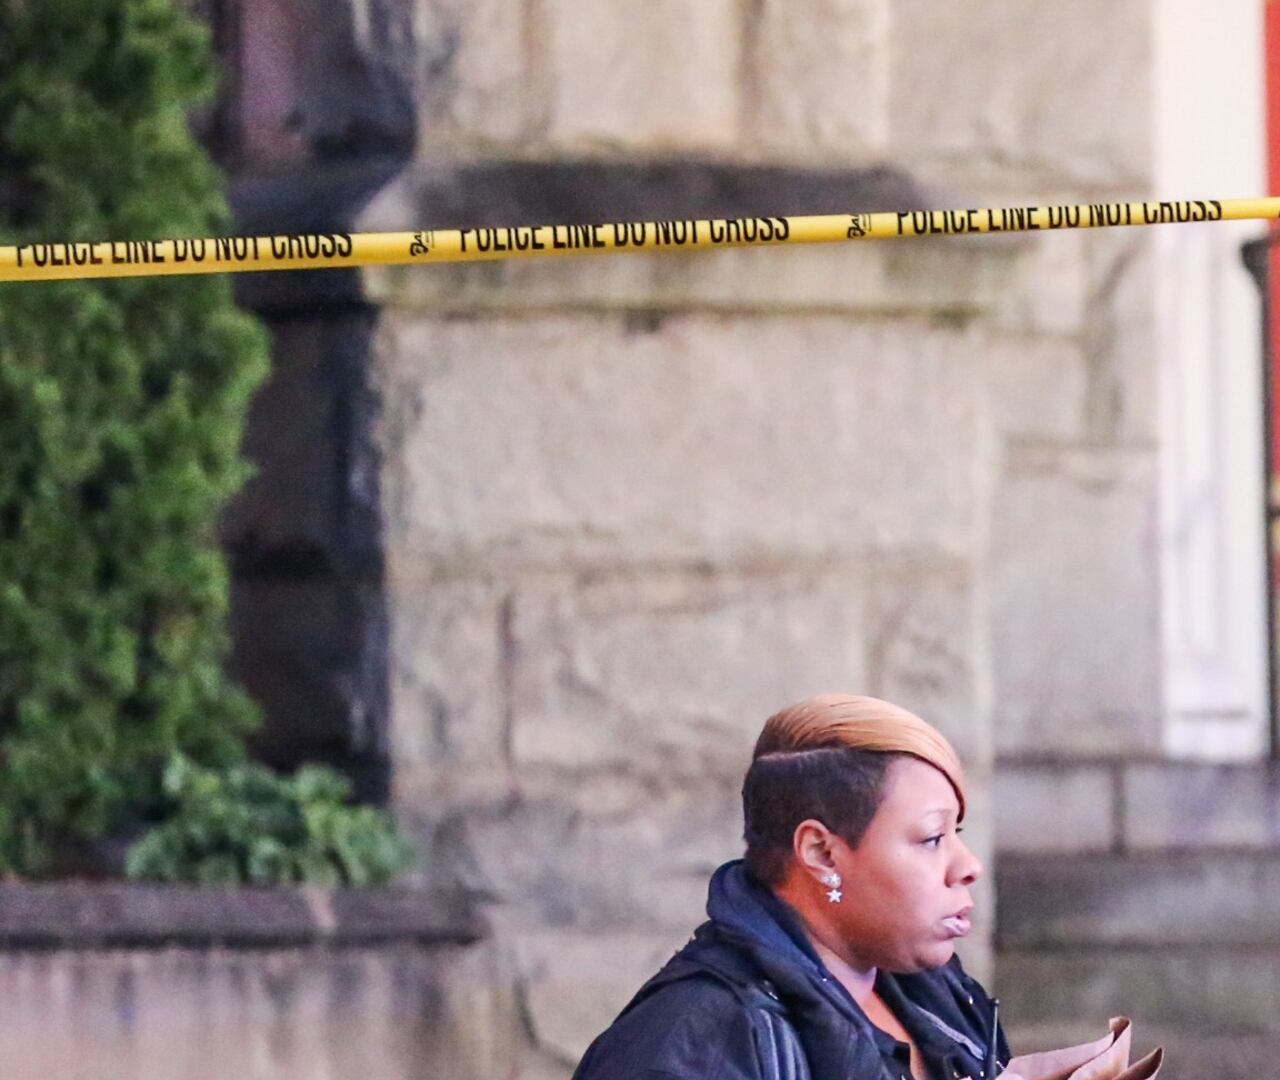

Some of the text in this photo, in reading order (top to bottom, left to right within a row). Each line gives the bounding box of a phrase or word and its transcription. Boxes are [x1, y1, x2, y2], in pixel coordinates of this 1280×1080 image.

[897, 200, 1222, 234] POLICE LINE DO NOT CROSS
[16, 234, 352, 266] POLICE LINE DO NOT CROSS
[460, 217, 790, 252] POLICE LINE DO NOT CROSS
